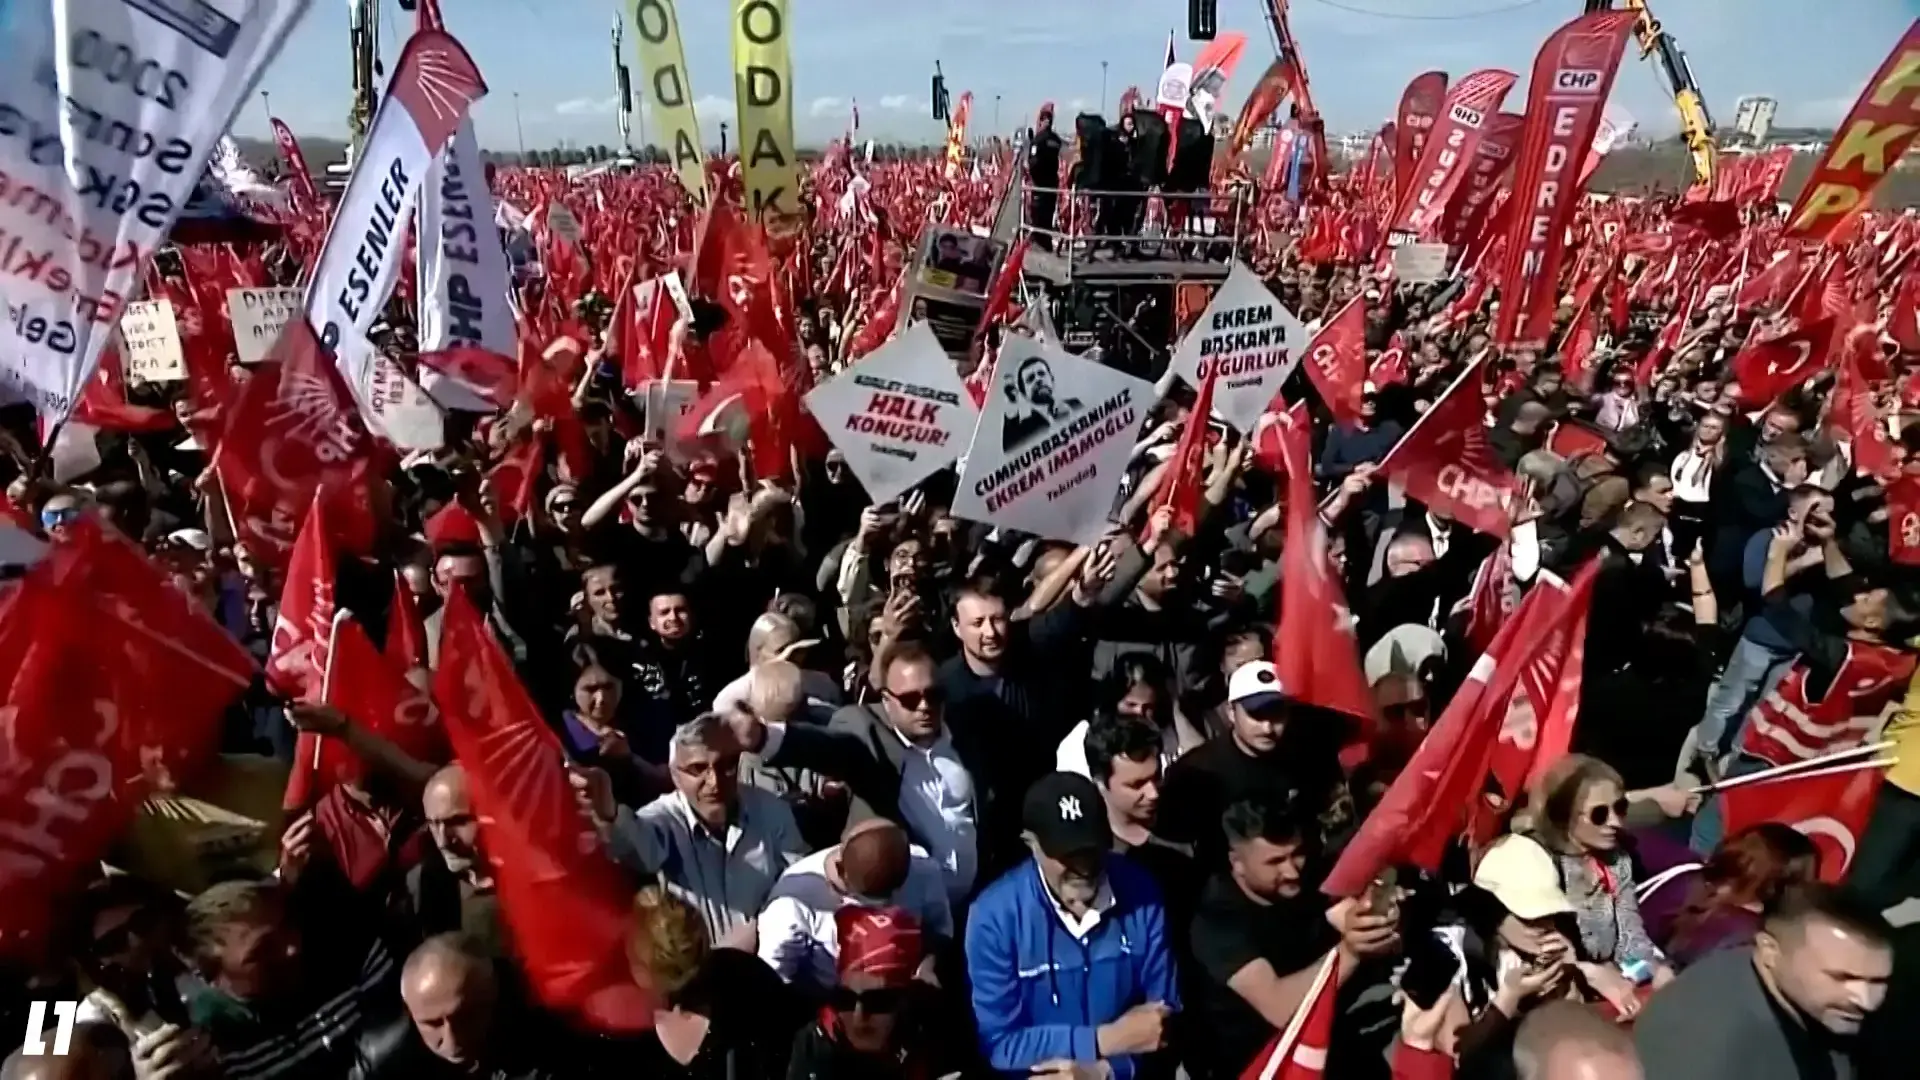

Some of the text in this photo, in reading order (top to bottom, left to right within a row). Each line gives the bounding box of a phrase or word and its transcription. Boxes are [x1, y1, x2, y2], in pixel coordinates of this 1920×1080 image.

[1558, 72, 1598, 89] CHP
[742, 1, 787, 223] ODAK
[339, 156, 409, 322] ESENLER
[1212, 304, 1273, 330] EKREM
[866, 393, 941, 425] HALK
[844, 413, 952, 448] KONUŞUR!
[974, 387, 1133, 497] CUMHURBAŞKANIMIZ
[985, 464, 1045, 515] EKREM
[1058, 795, 1083, 820] NY
